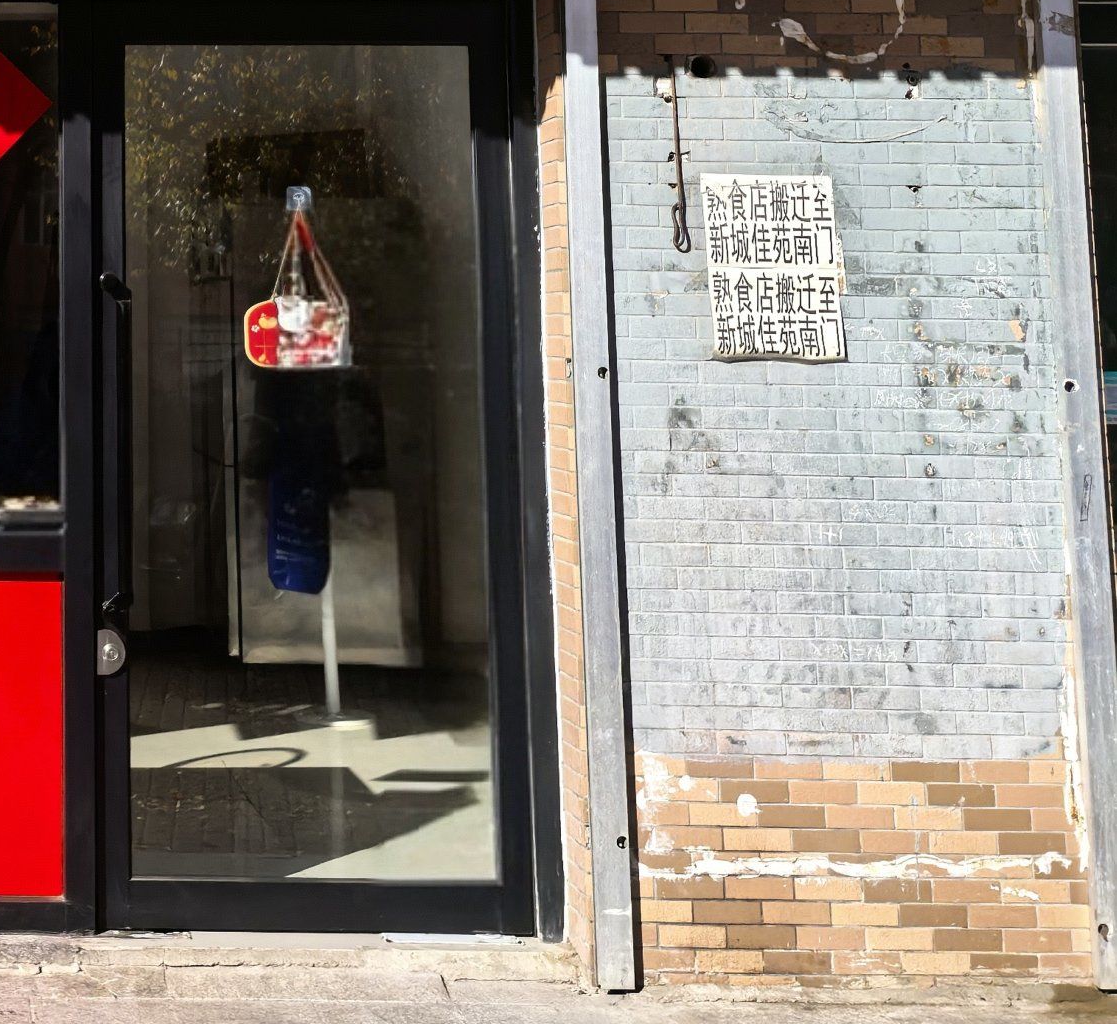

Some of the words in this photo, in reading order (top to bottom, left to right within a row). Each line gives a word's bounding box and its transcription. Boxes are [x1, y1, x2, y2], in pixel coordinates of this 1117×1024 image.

[705, 178, 833, 223] 熟食店搬迁至
[709, 222, 834, 266] 新城佳苑南门
[712, 270, 838, 315] 熟食店搬迁至
[716, 313, 842, 358] 新城佳苑南门
